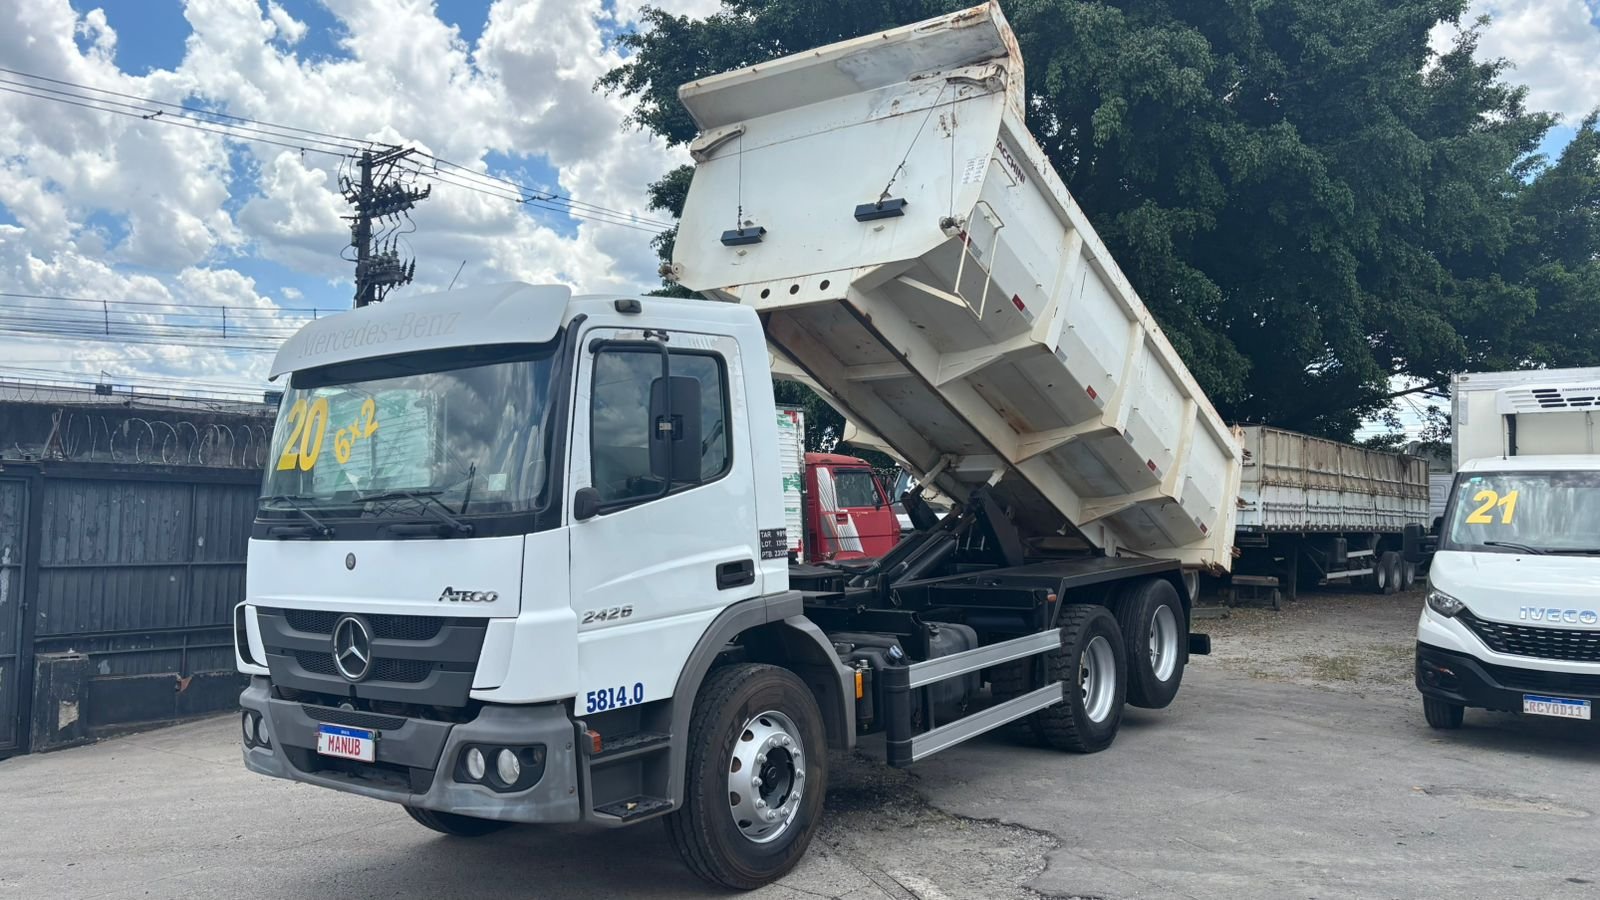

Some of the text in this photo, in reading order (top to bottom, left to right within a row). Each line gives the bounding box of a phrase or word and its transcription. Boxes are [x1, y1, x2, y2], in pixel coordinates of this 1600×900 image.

[996, 138, 1025, 184] ACCHINI
[300, 311, 460, 357] Mercedes-Benz
[277, 397, 328, 471] 20
[335, 398, 379, 464] 6x2
[1465, 490, 1518, 523] 21
[582, 605, 633, 624] 2426
[1519, 607, 1598, 624] IVECO
[586, 682, 644, 713] 5814.0
[328, 735, 361, 756] MANUB
